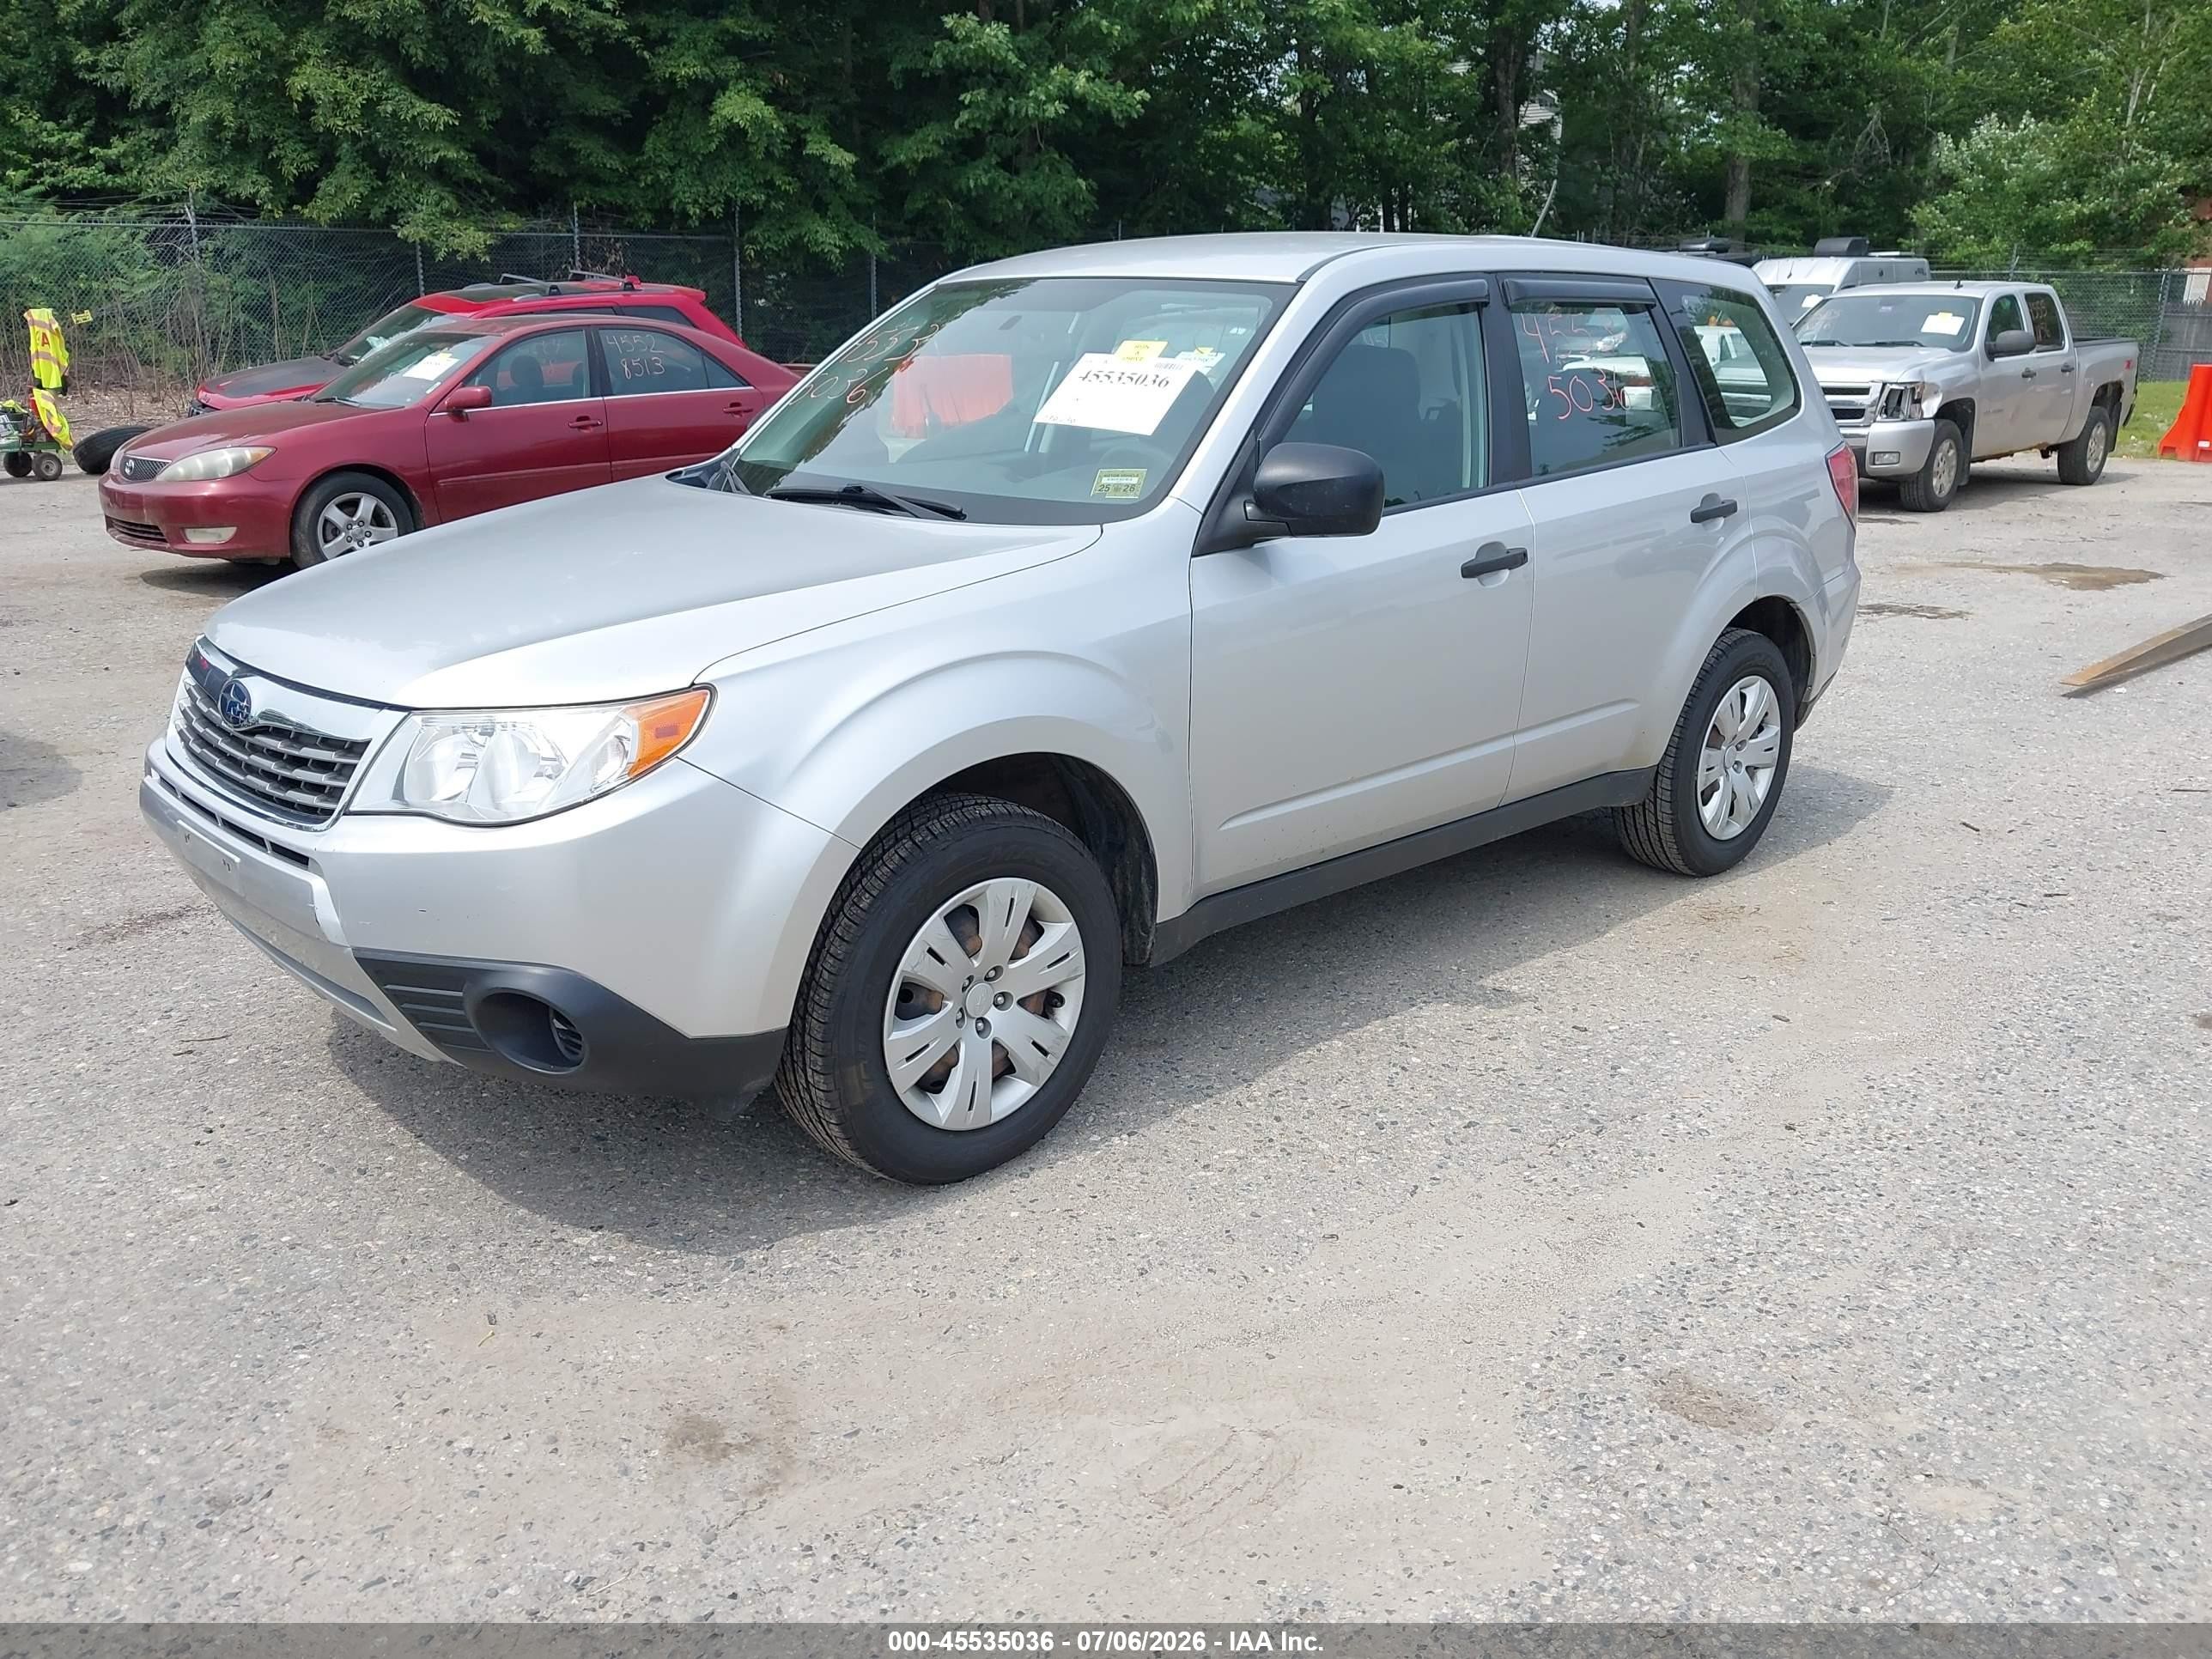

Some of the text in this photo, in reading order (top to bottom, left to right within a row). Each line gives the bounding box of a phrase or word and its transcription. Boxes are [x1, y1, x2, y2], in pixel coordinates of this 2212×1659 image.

[605, 334, 665, 354] 4552
[620, 356, 665, 380] 8513
[1079, 370, 1170, 387] 45535036
[1547, 365, 1631, 420] 5036
[1098, 483, 1110, 492] 25
[1123, 483, 1135, 492] 26
